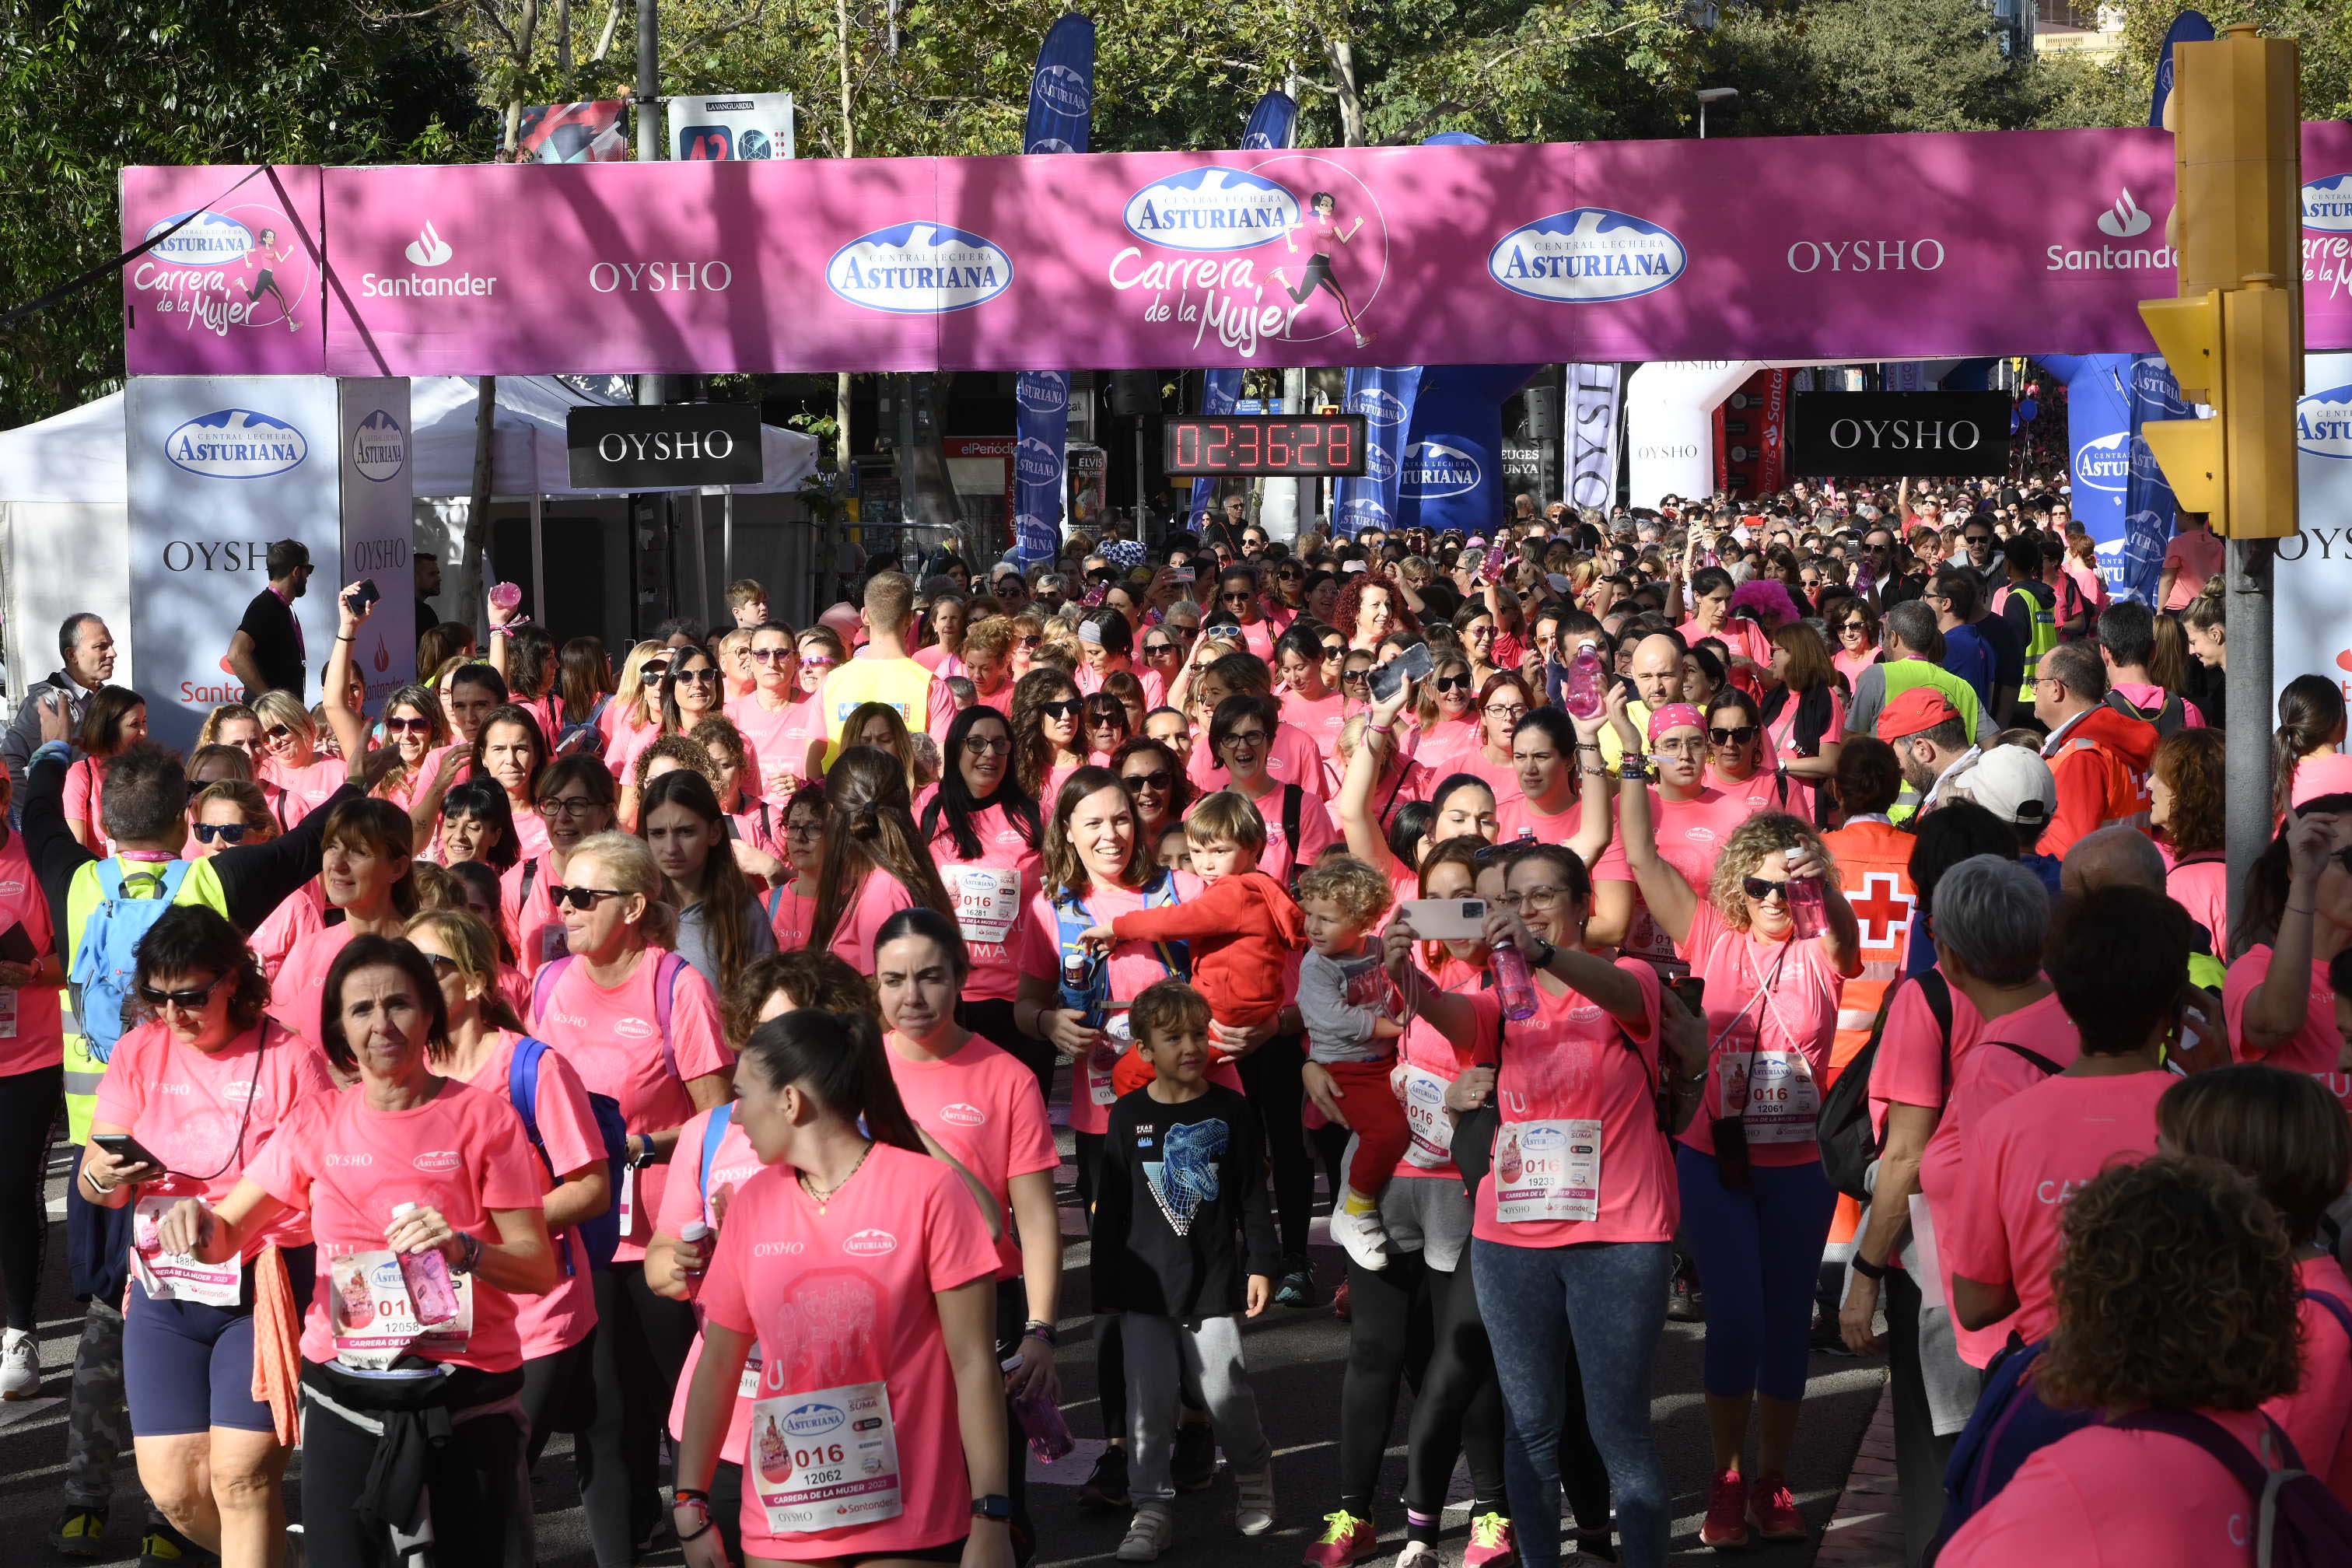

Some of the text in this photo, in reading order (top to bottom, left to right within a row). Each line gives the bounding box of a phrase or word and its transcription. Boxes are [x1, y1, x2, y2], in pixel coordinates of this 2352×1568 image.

[1137, 199, 1286, 229] ASTURIANA
[1534, 240, 1664, 250] CENTRAL LECHERA
[1788, 238, 1944, 273] OYSHO
[869, 253, 992, 262] CENTRAL LECHERA
[1108, 247, 1255, 289] Carrera
[1503, 244, 1672, 278] ASTURIANA
[135, 262, 226, 291] Carrera
[589, 261, 732, 293] OYSHO
[842, 256, 998, 289] ASTURIANA
[2319, 260, 2333, 282] la
[362, 272, 496, 297] Santander
[156, 290, 259, 336] de la Mujer
[1145, 285, 1308, 357] de la Mujer
[1830, 418, 1980, 450] OYSHO
[176, 436, 297, 461] ASTURIANA
[356, 436, 402, 464] ASTURIANA
[598, 429, 733, 462] OYSHO
[1178, 425, 1349, 467] 02:36:28
[1638, 444, 1698, 460] OYSHO
[1079, 458, 1102, 467] ELVIS
[2081, 454, 2129, 476] ASTU
[355, 537, 406, 572] OYSHO
[964, 878, 994, 887] ASTURIANA
[964, 895, 991, 907] 016
[1754, 1088, 1787, 1101] 016
[944, 1111, 982, 1122] ASTURIANA
[1410, 1105, 1433, 1125] 016
[1412, 1122, 1428, 1137] 15341
[1525, 1159, 1561, 1173] 016
[1529, 1178, 1555, 1186] 19233
[1161, 1206, 1182, 1237] MONSTERS
[754, 1242, 804, 1258] OYSHO
[849, 1240, 893, 1250] ASTURIANA
[191, 1272, 212, 1280] MUJER
[379, 1300, 415, 1316] 01
[385, 1323, 419, 1332] 12058
[849, 1400, 877, 1412] SUMA
[787, 1416, 841, 1432] ASTURIANA
[795, 1444, 844, 1468] 016
[803, 1469, 842, 1486] 12062
[774, 1480, 887, 1504] CARRERA DE LA MUJER 2023
[778, 1499, 893, 1524] OYSHO Santander
